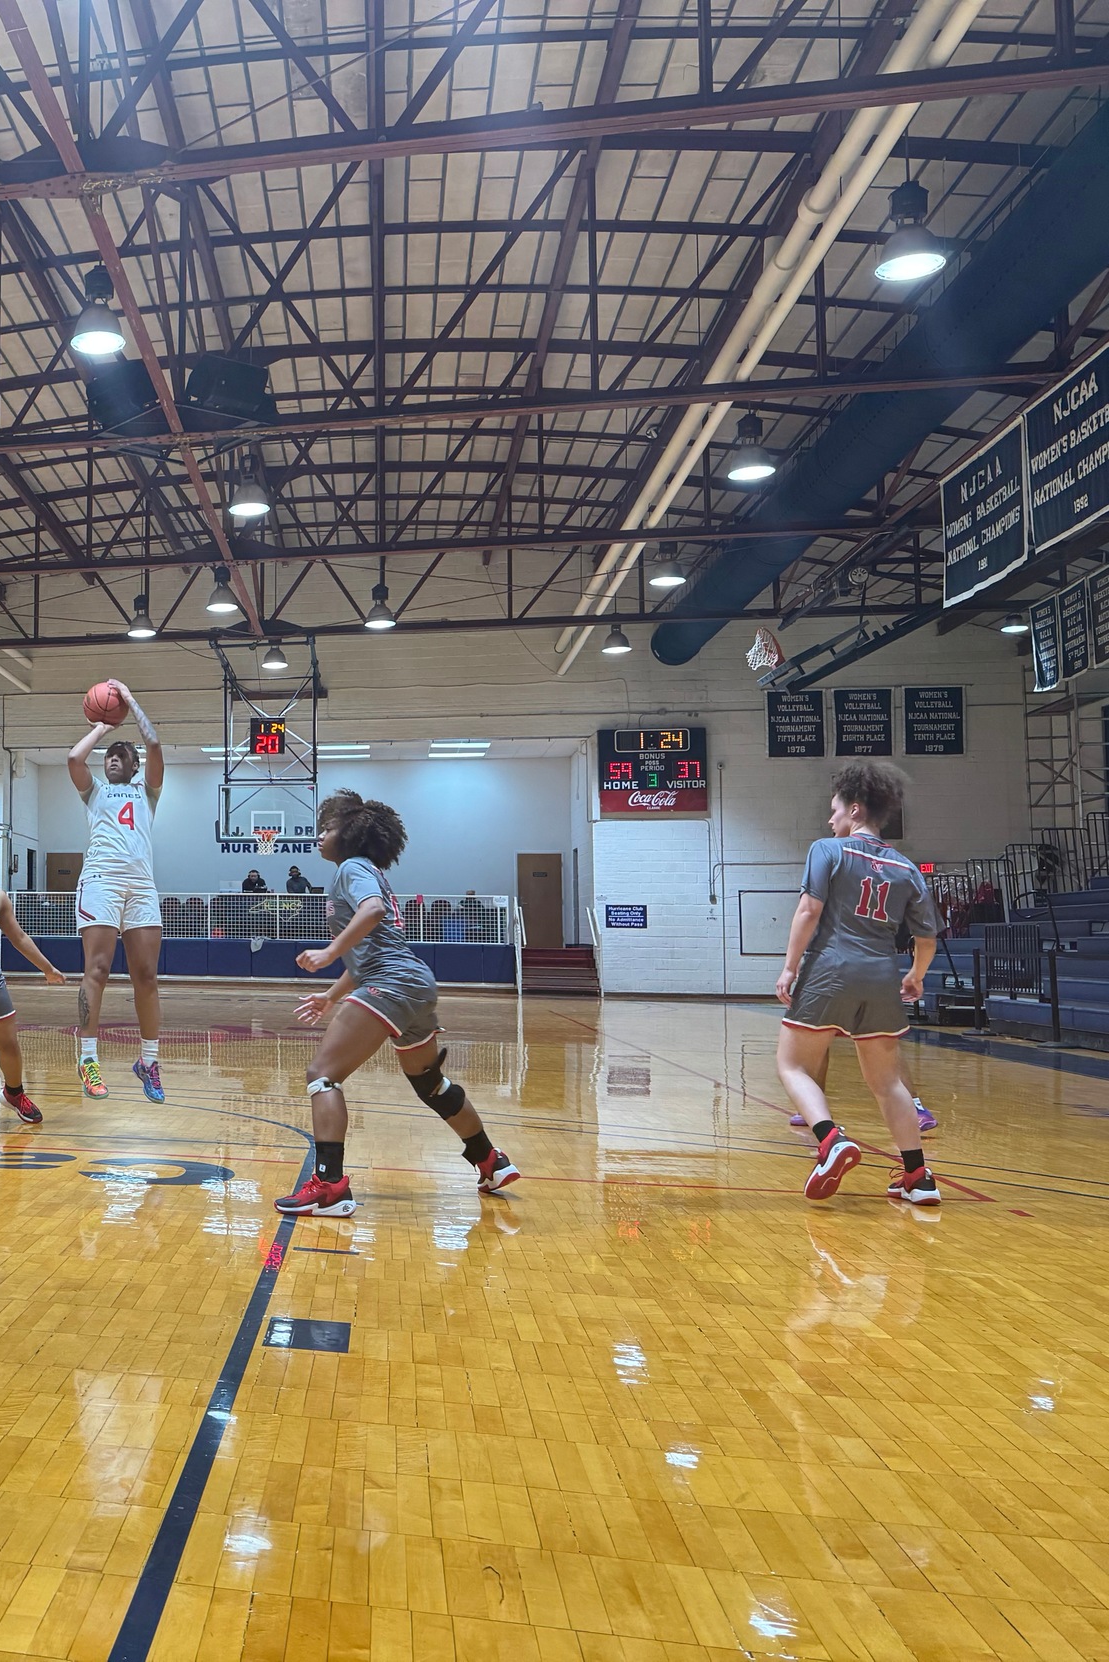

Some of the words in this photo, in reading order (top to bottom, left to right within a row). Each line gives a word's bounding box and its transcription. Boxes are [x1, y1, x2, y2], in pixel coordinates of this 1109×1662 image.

[1053, 371, 1099, 426] NJCAA
[1031, 434, 1068, 475] WOMEN'S
[960, 455, 1003, 504] NJCAA
[1033, 467, 1076, 509] NATIONAL
[976, 476, 1021, 521] BASKETBALL
[946, 535, 980, 567] NATIONAL
[981, 505, 1021, 546] CHAMPIONS
[919, 691, 948, 699] WOMEN'S
[777, 704, 814, 712] VOLLEYBALL
[844, 702, 882, 710] VOLLEYBALL
[771, 715, 790, 723] NJCAA
[792, 715, 821, 723] NATIONAL
[859, 713, 889, 721] NATIONAL
[908, 712, 928, 720] NJCAA
[929, 712, 961, 720] NATIONAL
[913, 723, 955, 731] TOURNAMENT
[640, 731, 683, 749] 1:24
[842, 734, 864, 742] EIGHTH
[913, 733, 934, 741] TENTH
[255, 735, 279, 754] 20
[609, 762, 632, 779] 59
[677, 761, 701, 778] 37
[604, 781, 639, 790] HOME
[648, 773, 658, 787] 3
[667, 780, 706, 788] VISITOR
[628, 790, 679, 807] Coca-Cola
[117, 801, 135, 831] 4
[220, 842, 317, 854] HURCANE'
[920, 863, 934, 873] EXIT
[854, 876, 891, 923] 11
